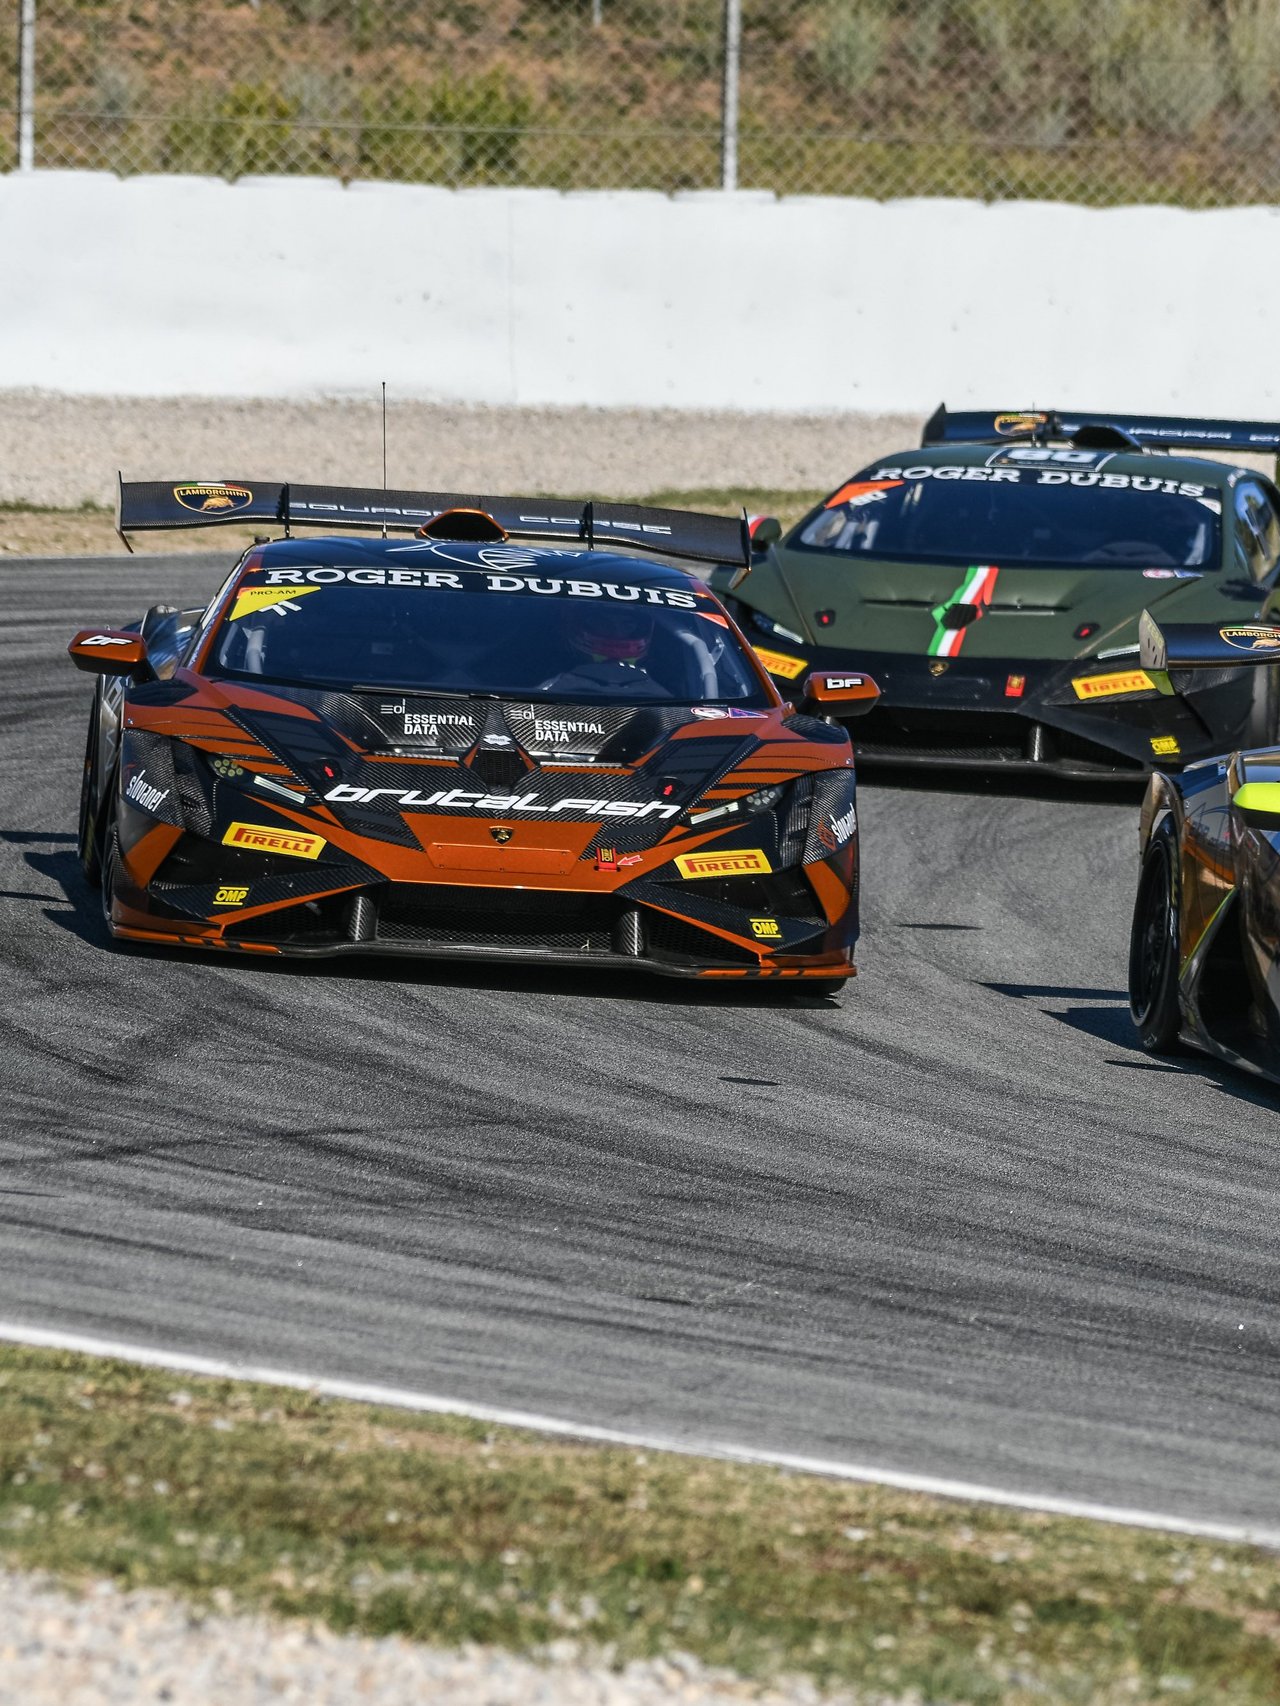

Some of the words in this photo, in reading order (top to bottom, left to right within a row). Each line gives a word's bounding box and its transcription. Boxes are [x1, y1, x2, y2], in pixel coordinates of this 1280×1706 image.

[870, 466, 1021, 482] ROGER
[1036, 471, 1205, 497] DUBUIS
[179, 487, 248, 498] LAMBORGHINI
[264, 568, 463, 589] ROGER
[486, 575, 697, 608] DUBUIS
[404, 713, 476, 726] ESSENTIAL
[535, 719, 606, 735] ESSENTIAL
[403, 723, 439, 736] DATA
[535, 729, 570, 742] DATA
[126, 769, 170, 812] slovanet
[233, 827, 316, 854] PIRELLI
[685, 851, 761, 874] PIRELLI
[213, 886, 249, 905] OMP
[751, 919, 781, 938] OMP
